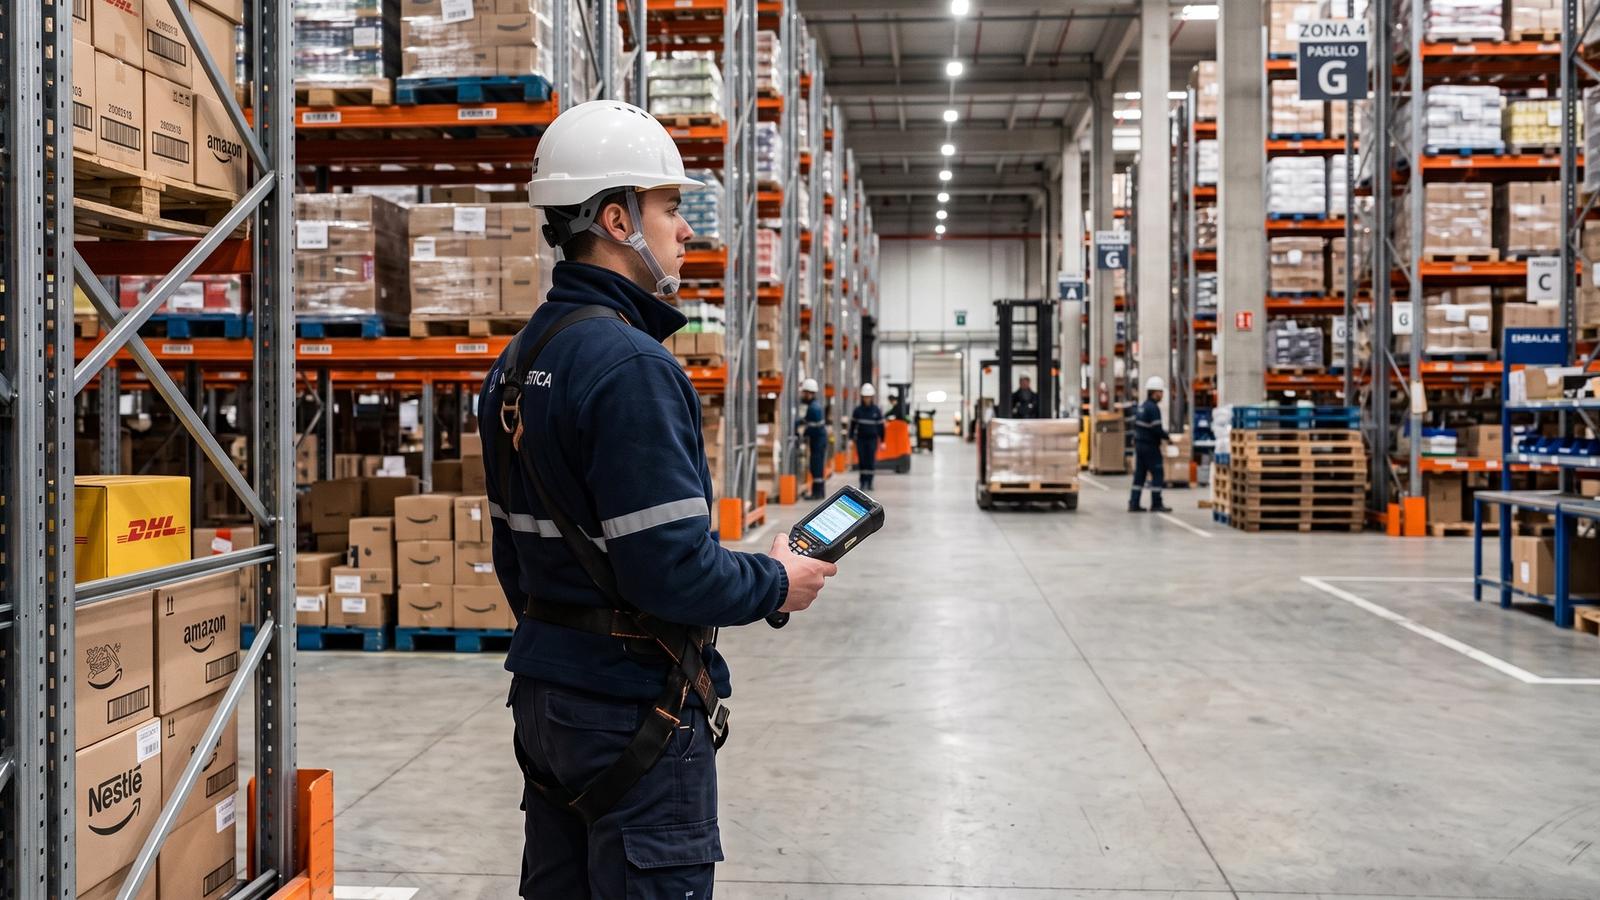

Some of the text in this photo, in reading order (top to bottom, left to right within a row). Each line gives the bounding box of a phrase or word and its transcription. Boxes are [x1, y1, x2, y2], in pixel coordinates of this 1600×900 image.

[1300, 24, 1366, 37] ZONA 4
[1306, 45, 1359, 57] PASILLO
[1317, 60, 1348, 95] G
[207, 134, 242, 158] amazon
[1105, 251, 1120, 268] G
[1538, 273, 1552, 291] C
[1067, 288, 1077, 298] A
[1511, 333, 1562, 344] EMBALAJE
[127, 515, 178, 542] DHL
[183, 614, 226, 644] amazon
[88, 764, 143, 817] Nestlé
